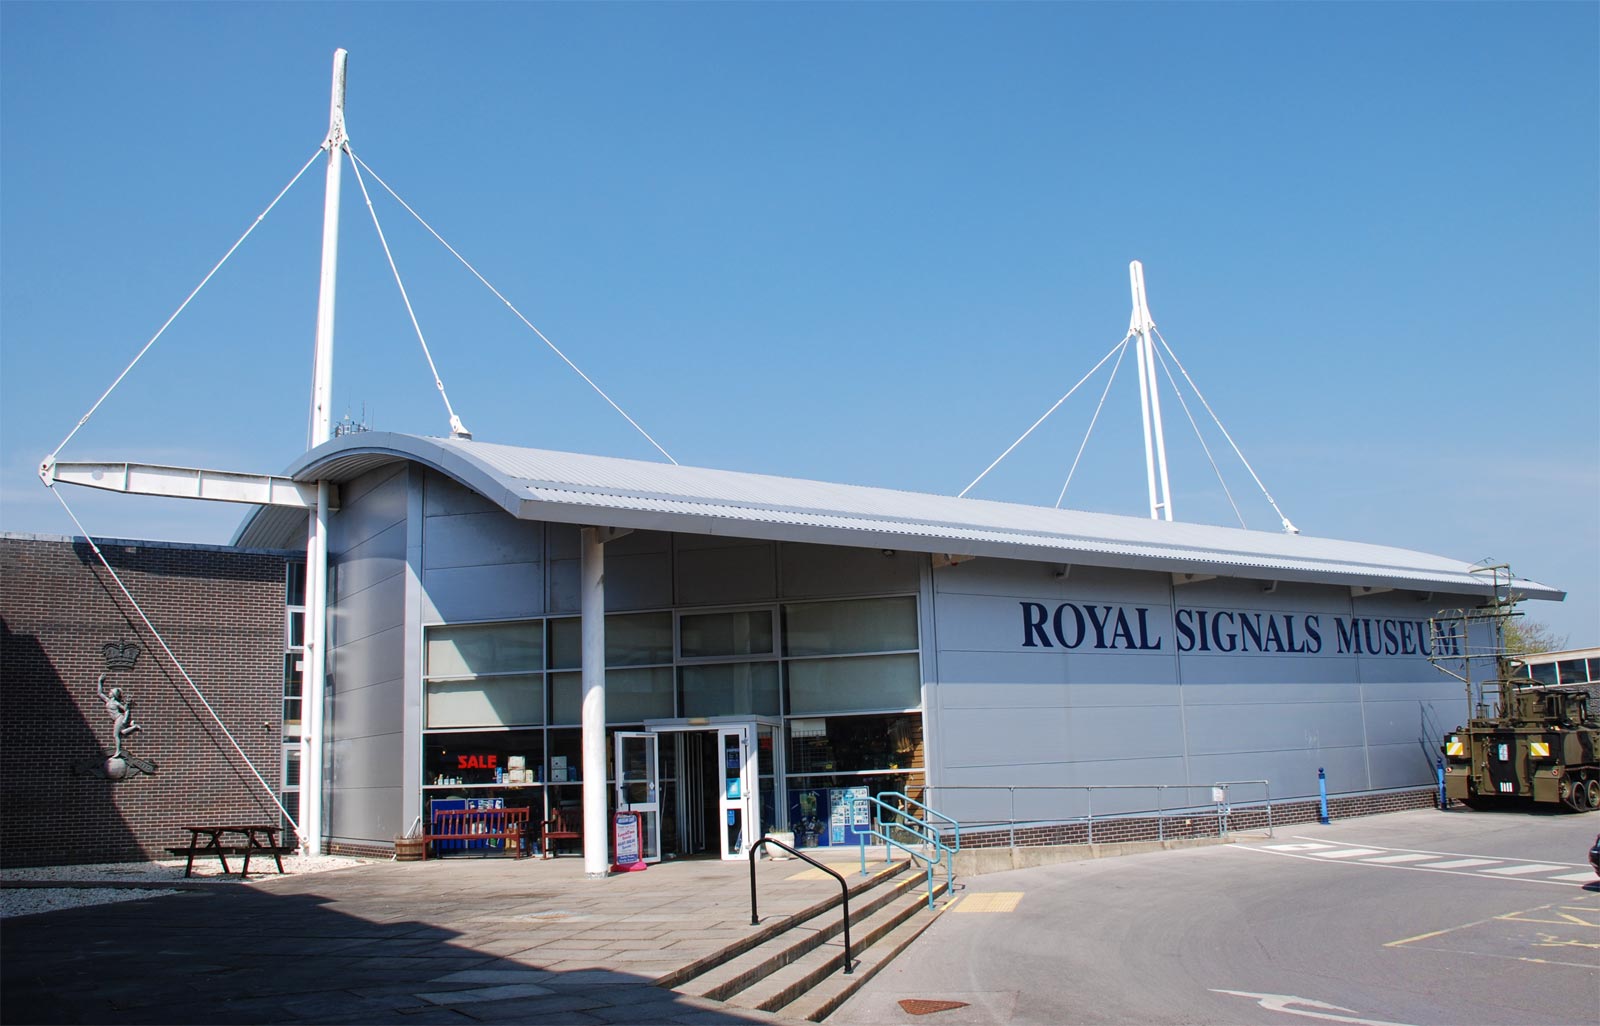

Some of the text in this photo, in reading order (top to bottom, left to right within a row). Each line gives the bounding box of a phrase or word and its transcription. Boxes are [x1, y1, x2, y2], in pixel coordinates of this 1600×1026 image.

[1019, 602, 1460, 656] ROYAL SIGNALS MUSEUM
[457, 755, 497, 769] SALE
